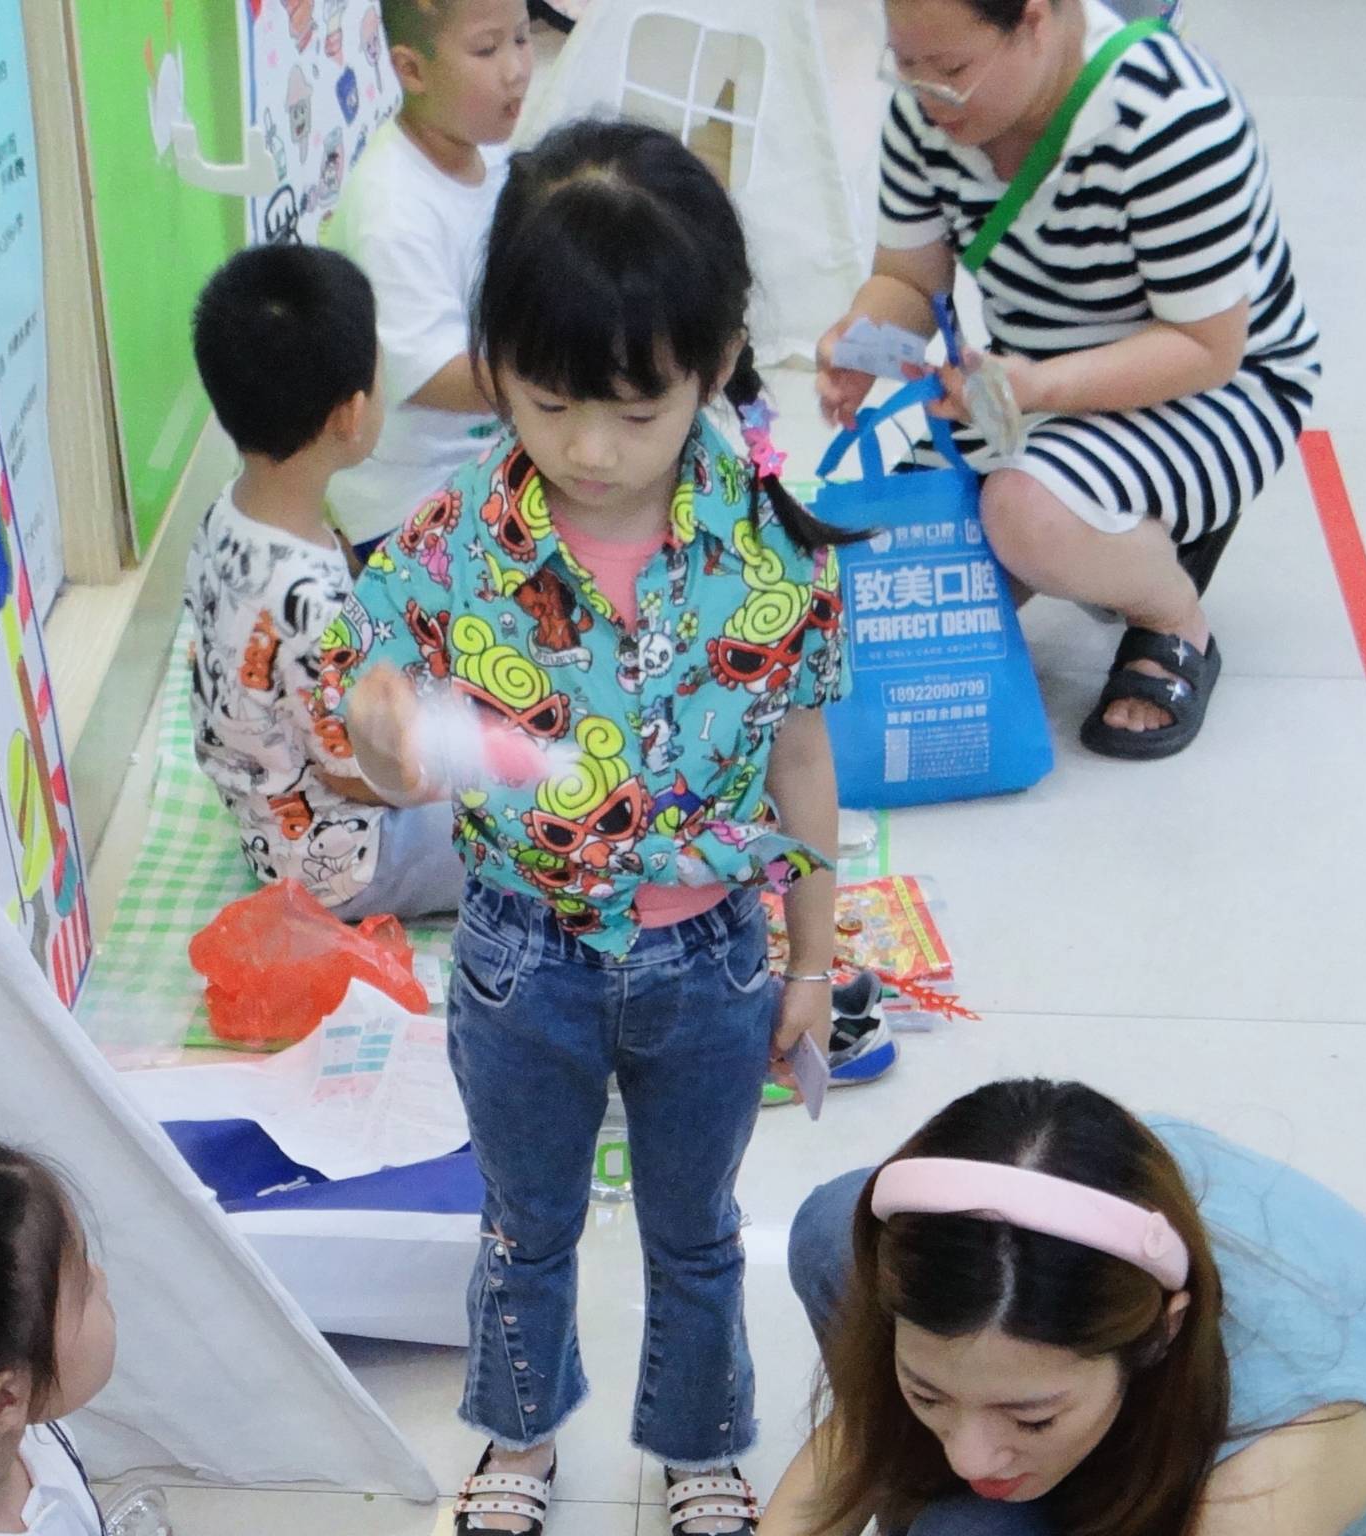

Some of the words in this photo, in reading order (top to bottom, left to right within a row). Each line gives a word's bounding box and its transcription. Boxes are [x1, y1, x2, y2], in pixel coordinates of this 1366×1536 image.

[854, 561, 998, 611] 致美口腔
[856, 612, 940, 644] PERFECT
[889, 680, 985, 704] 18922090799
